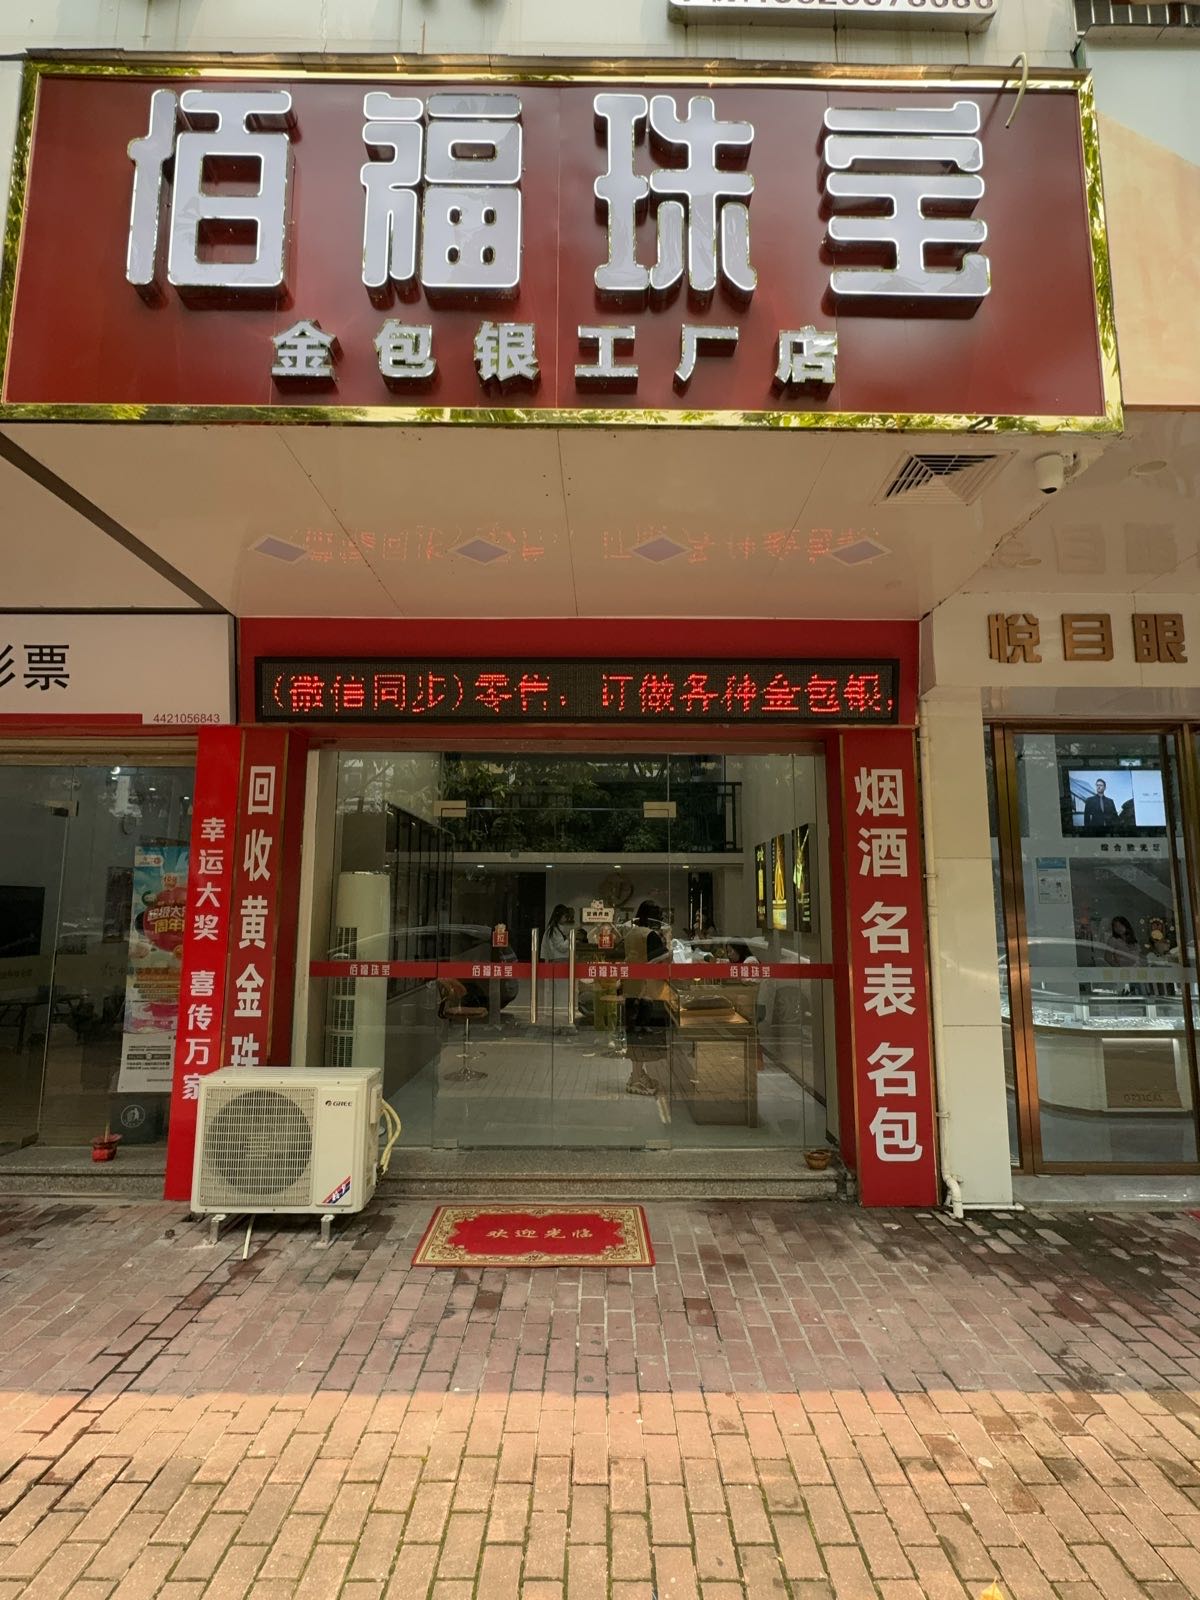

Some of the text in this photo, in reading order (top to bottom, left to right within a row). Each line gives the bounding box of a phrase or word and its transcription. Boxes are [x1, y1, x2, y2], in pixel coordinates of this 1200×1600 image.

[125, 87, 991, 300] 佰福珠宝
[271, 319, 840, 384] 金包银工厂店
[987, 613, 1188, 664] 悦目眼
[152, 713, 220, 723] 4421056843
[193, 817, 226, 941] 幸运大奖
[485, 1227, 593, 1239] 欢迎光临
